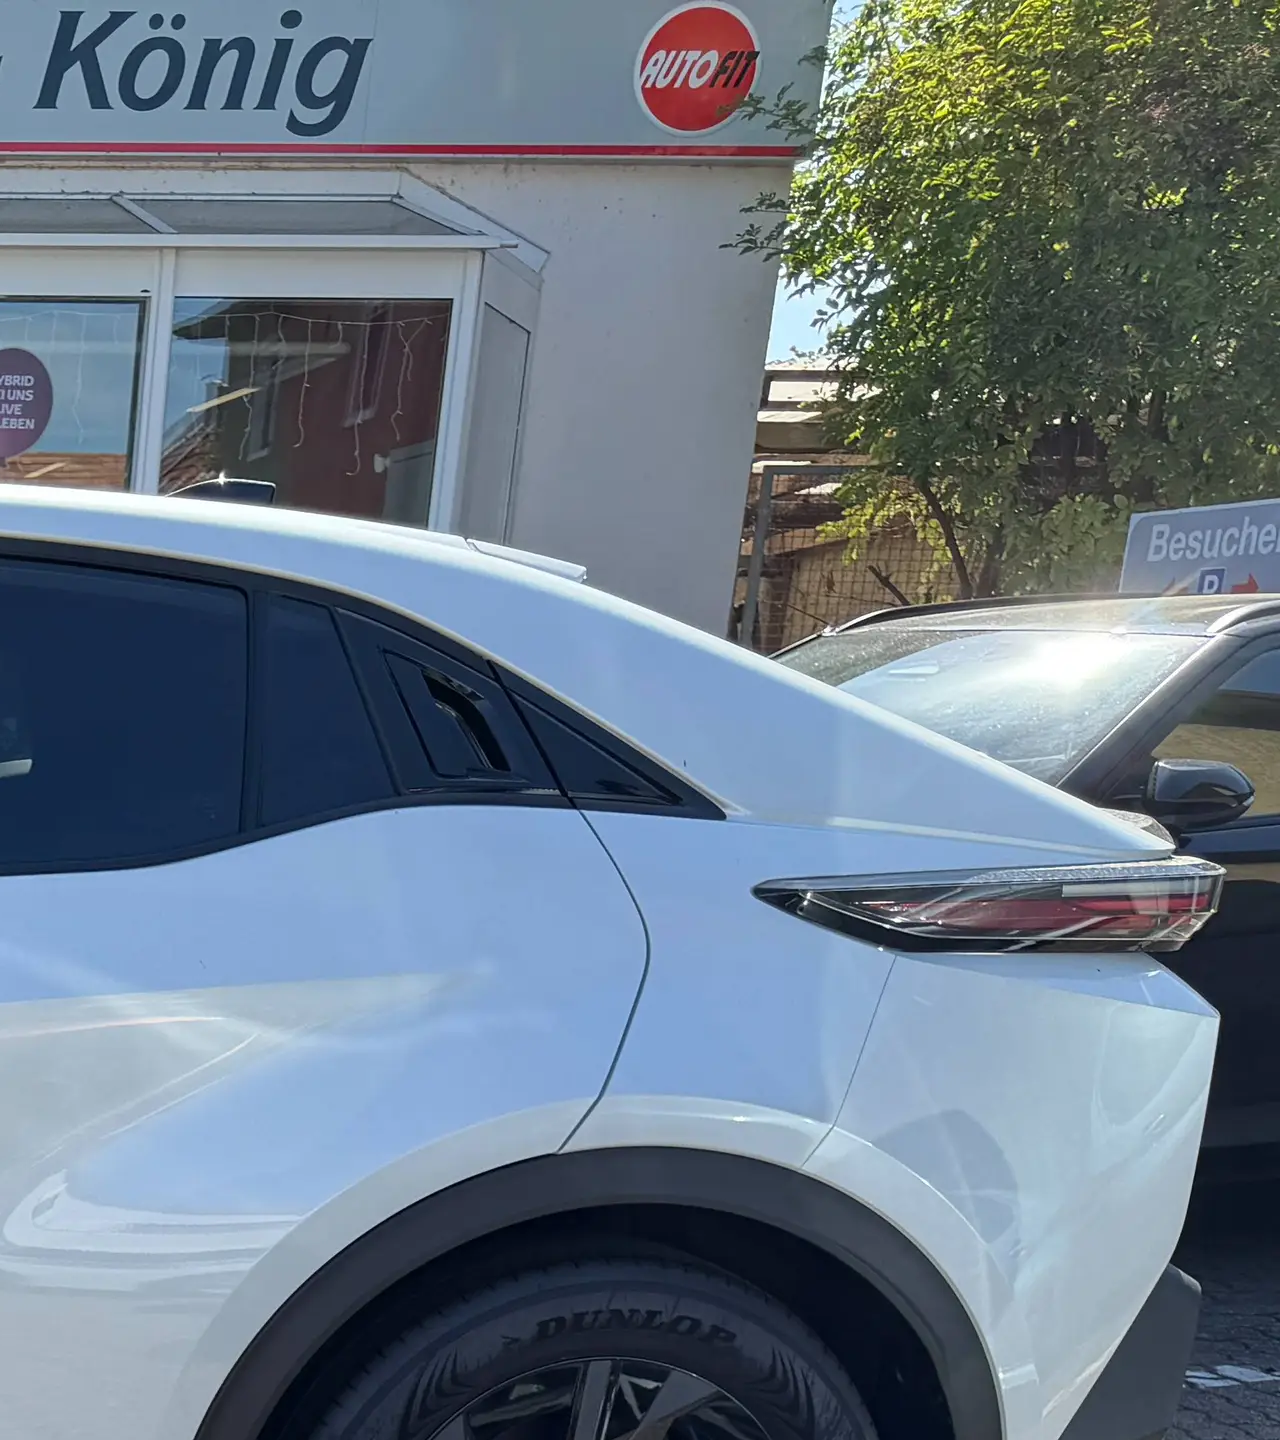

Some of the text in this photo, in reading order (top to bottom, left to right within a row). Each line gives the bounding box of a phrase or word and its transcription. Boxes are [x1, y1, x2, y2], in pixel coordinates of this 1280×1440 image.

[33, 9, 373, 138] König
[640, 50, 760, 89] AUTOFIT
[7, 389, 34, 401] UNS
[532, 1308, 737, 1343] DUNLOP
